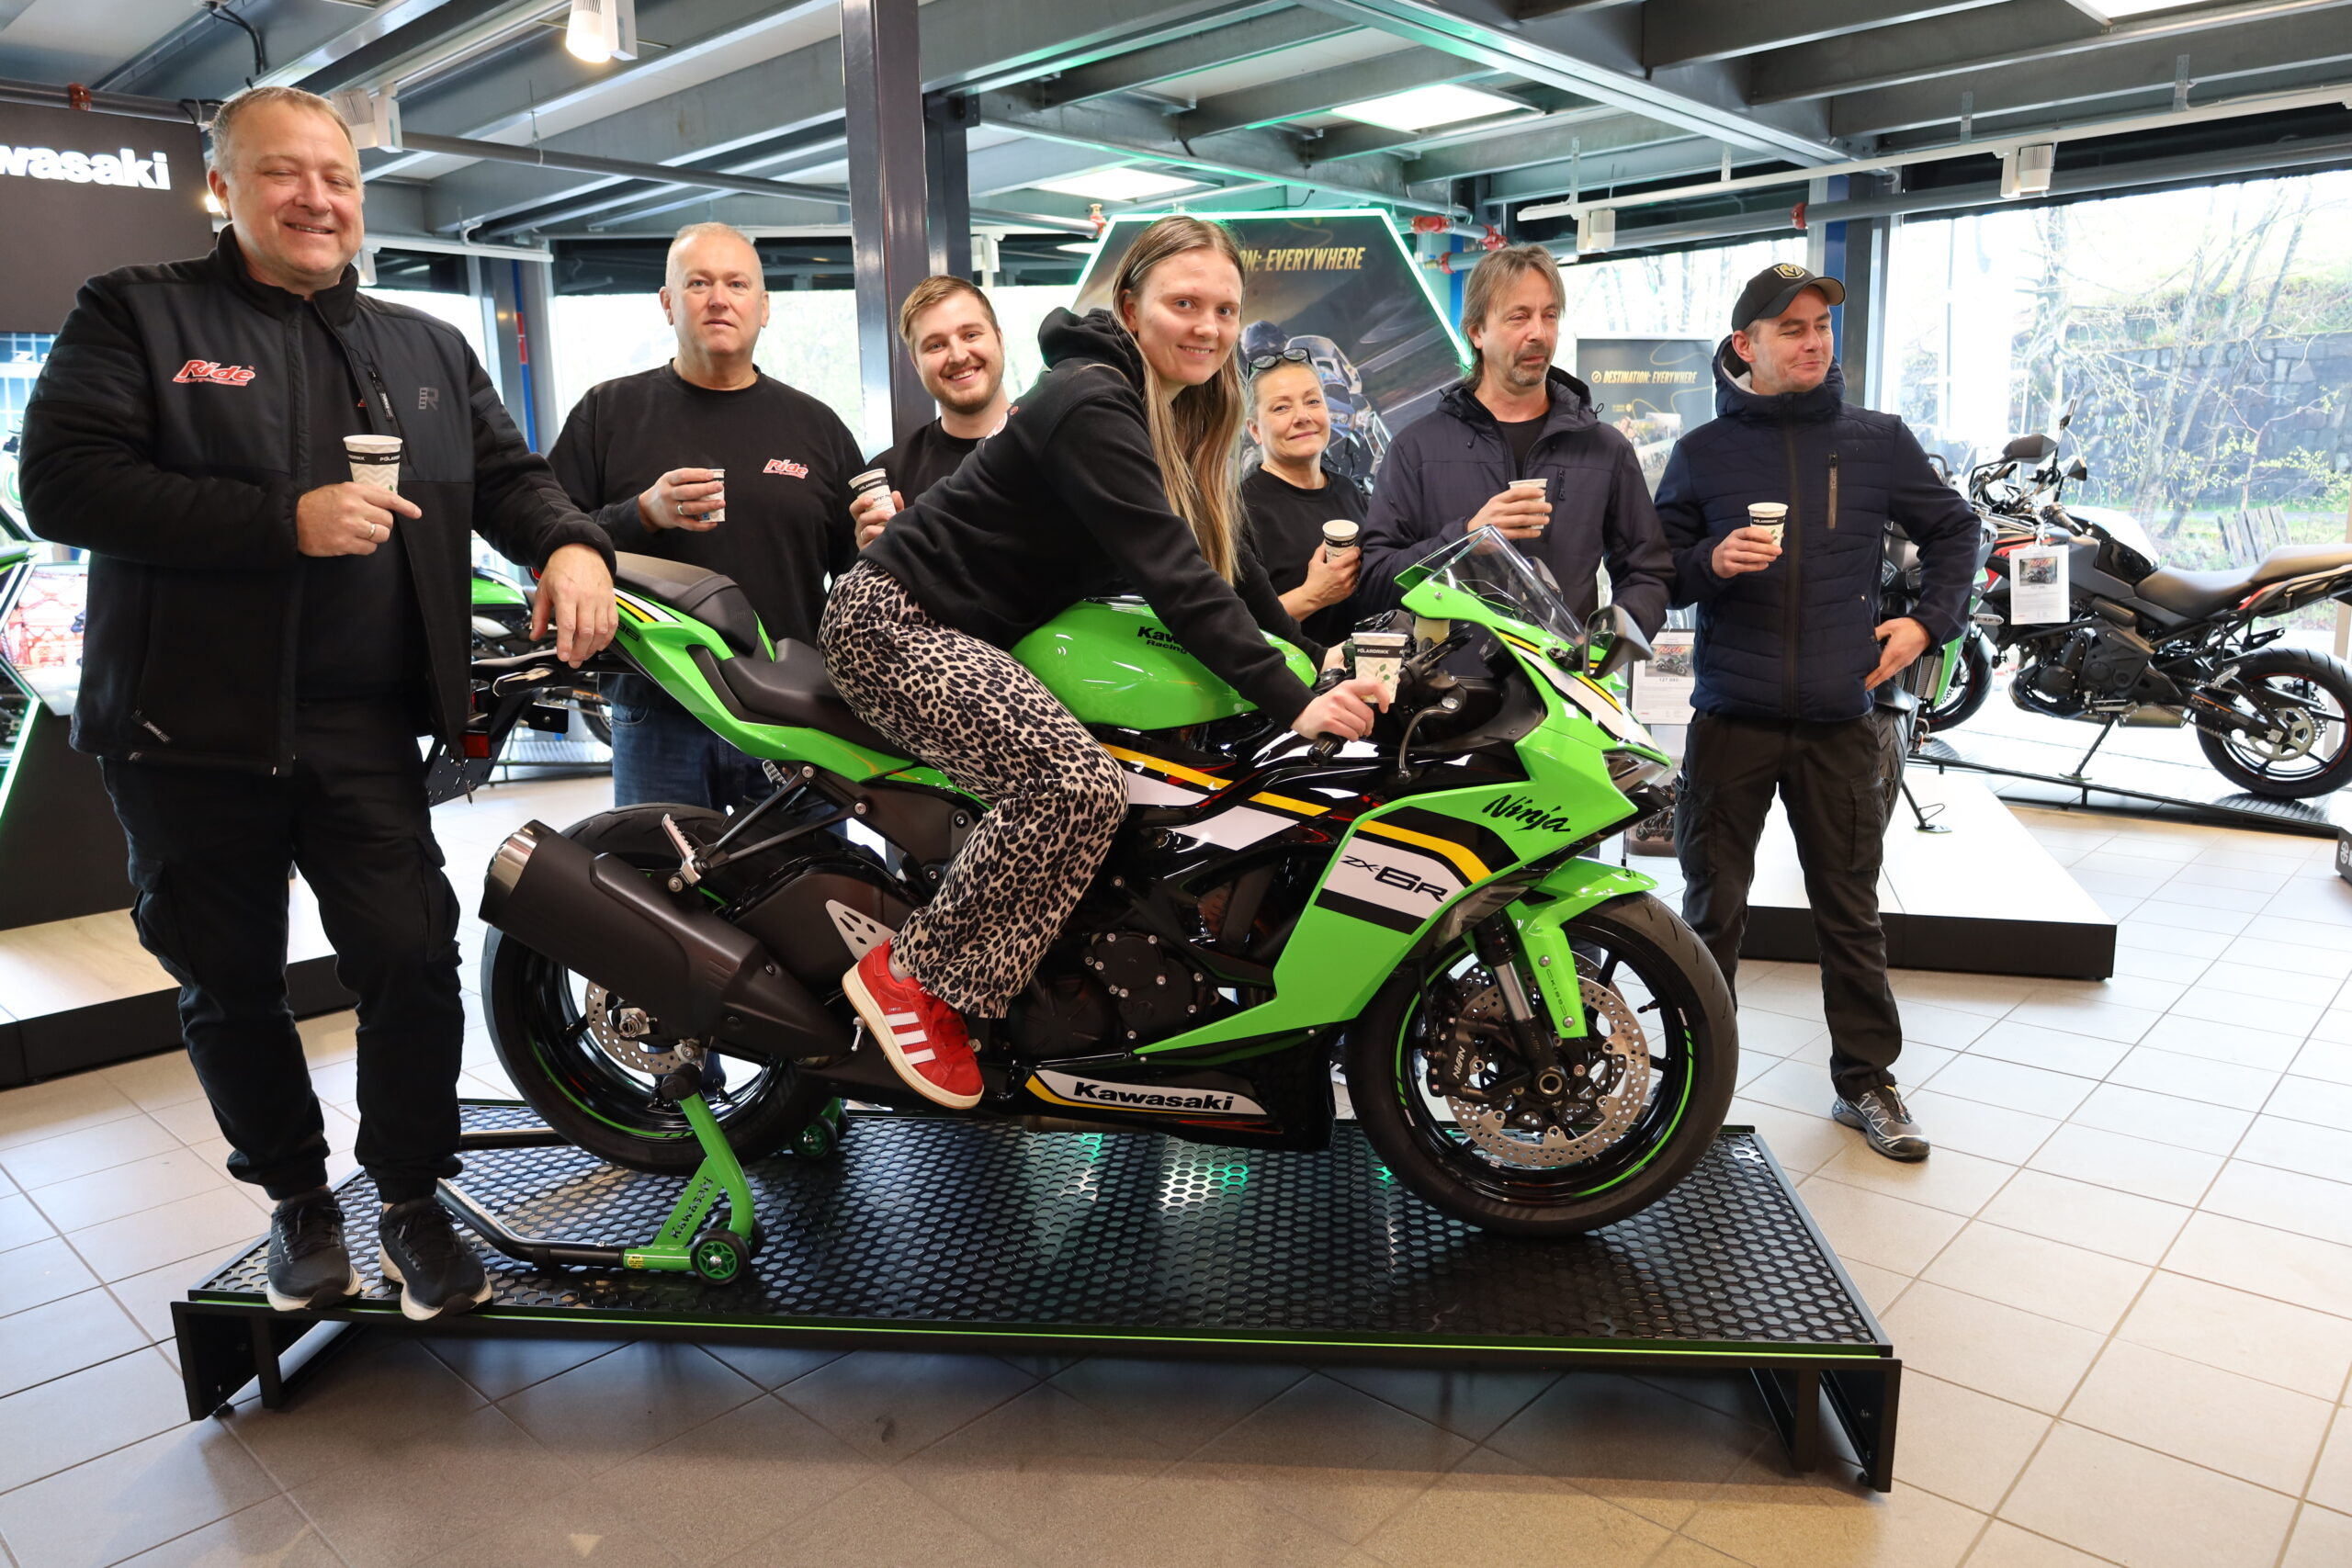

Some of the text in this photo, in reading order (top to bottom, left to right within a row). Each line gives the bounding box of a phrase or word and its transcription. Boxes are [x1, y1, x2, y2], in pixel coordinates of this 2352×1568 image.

[1264, 246, 1367, 272] EVERYWHERE
[176, 359, 256, 382] Ride
[1602, 369, 1698, 384] DESTINATION: EVERYWHERE
[763, 458, 808, 476] Ride
[1482, 794, 1571, 833] Ninja
[1340, 855, 1449, 903] ZX-6R
[1452, 1045, 1466, 1079] NISSIN
[1073, 1081, 1234, 1111] Kawasaki
[670, 1176, 715, 1239] Kawasaki
